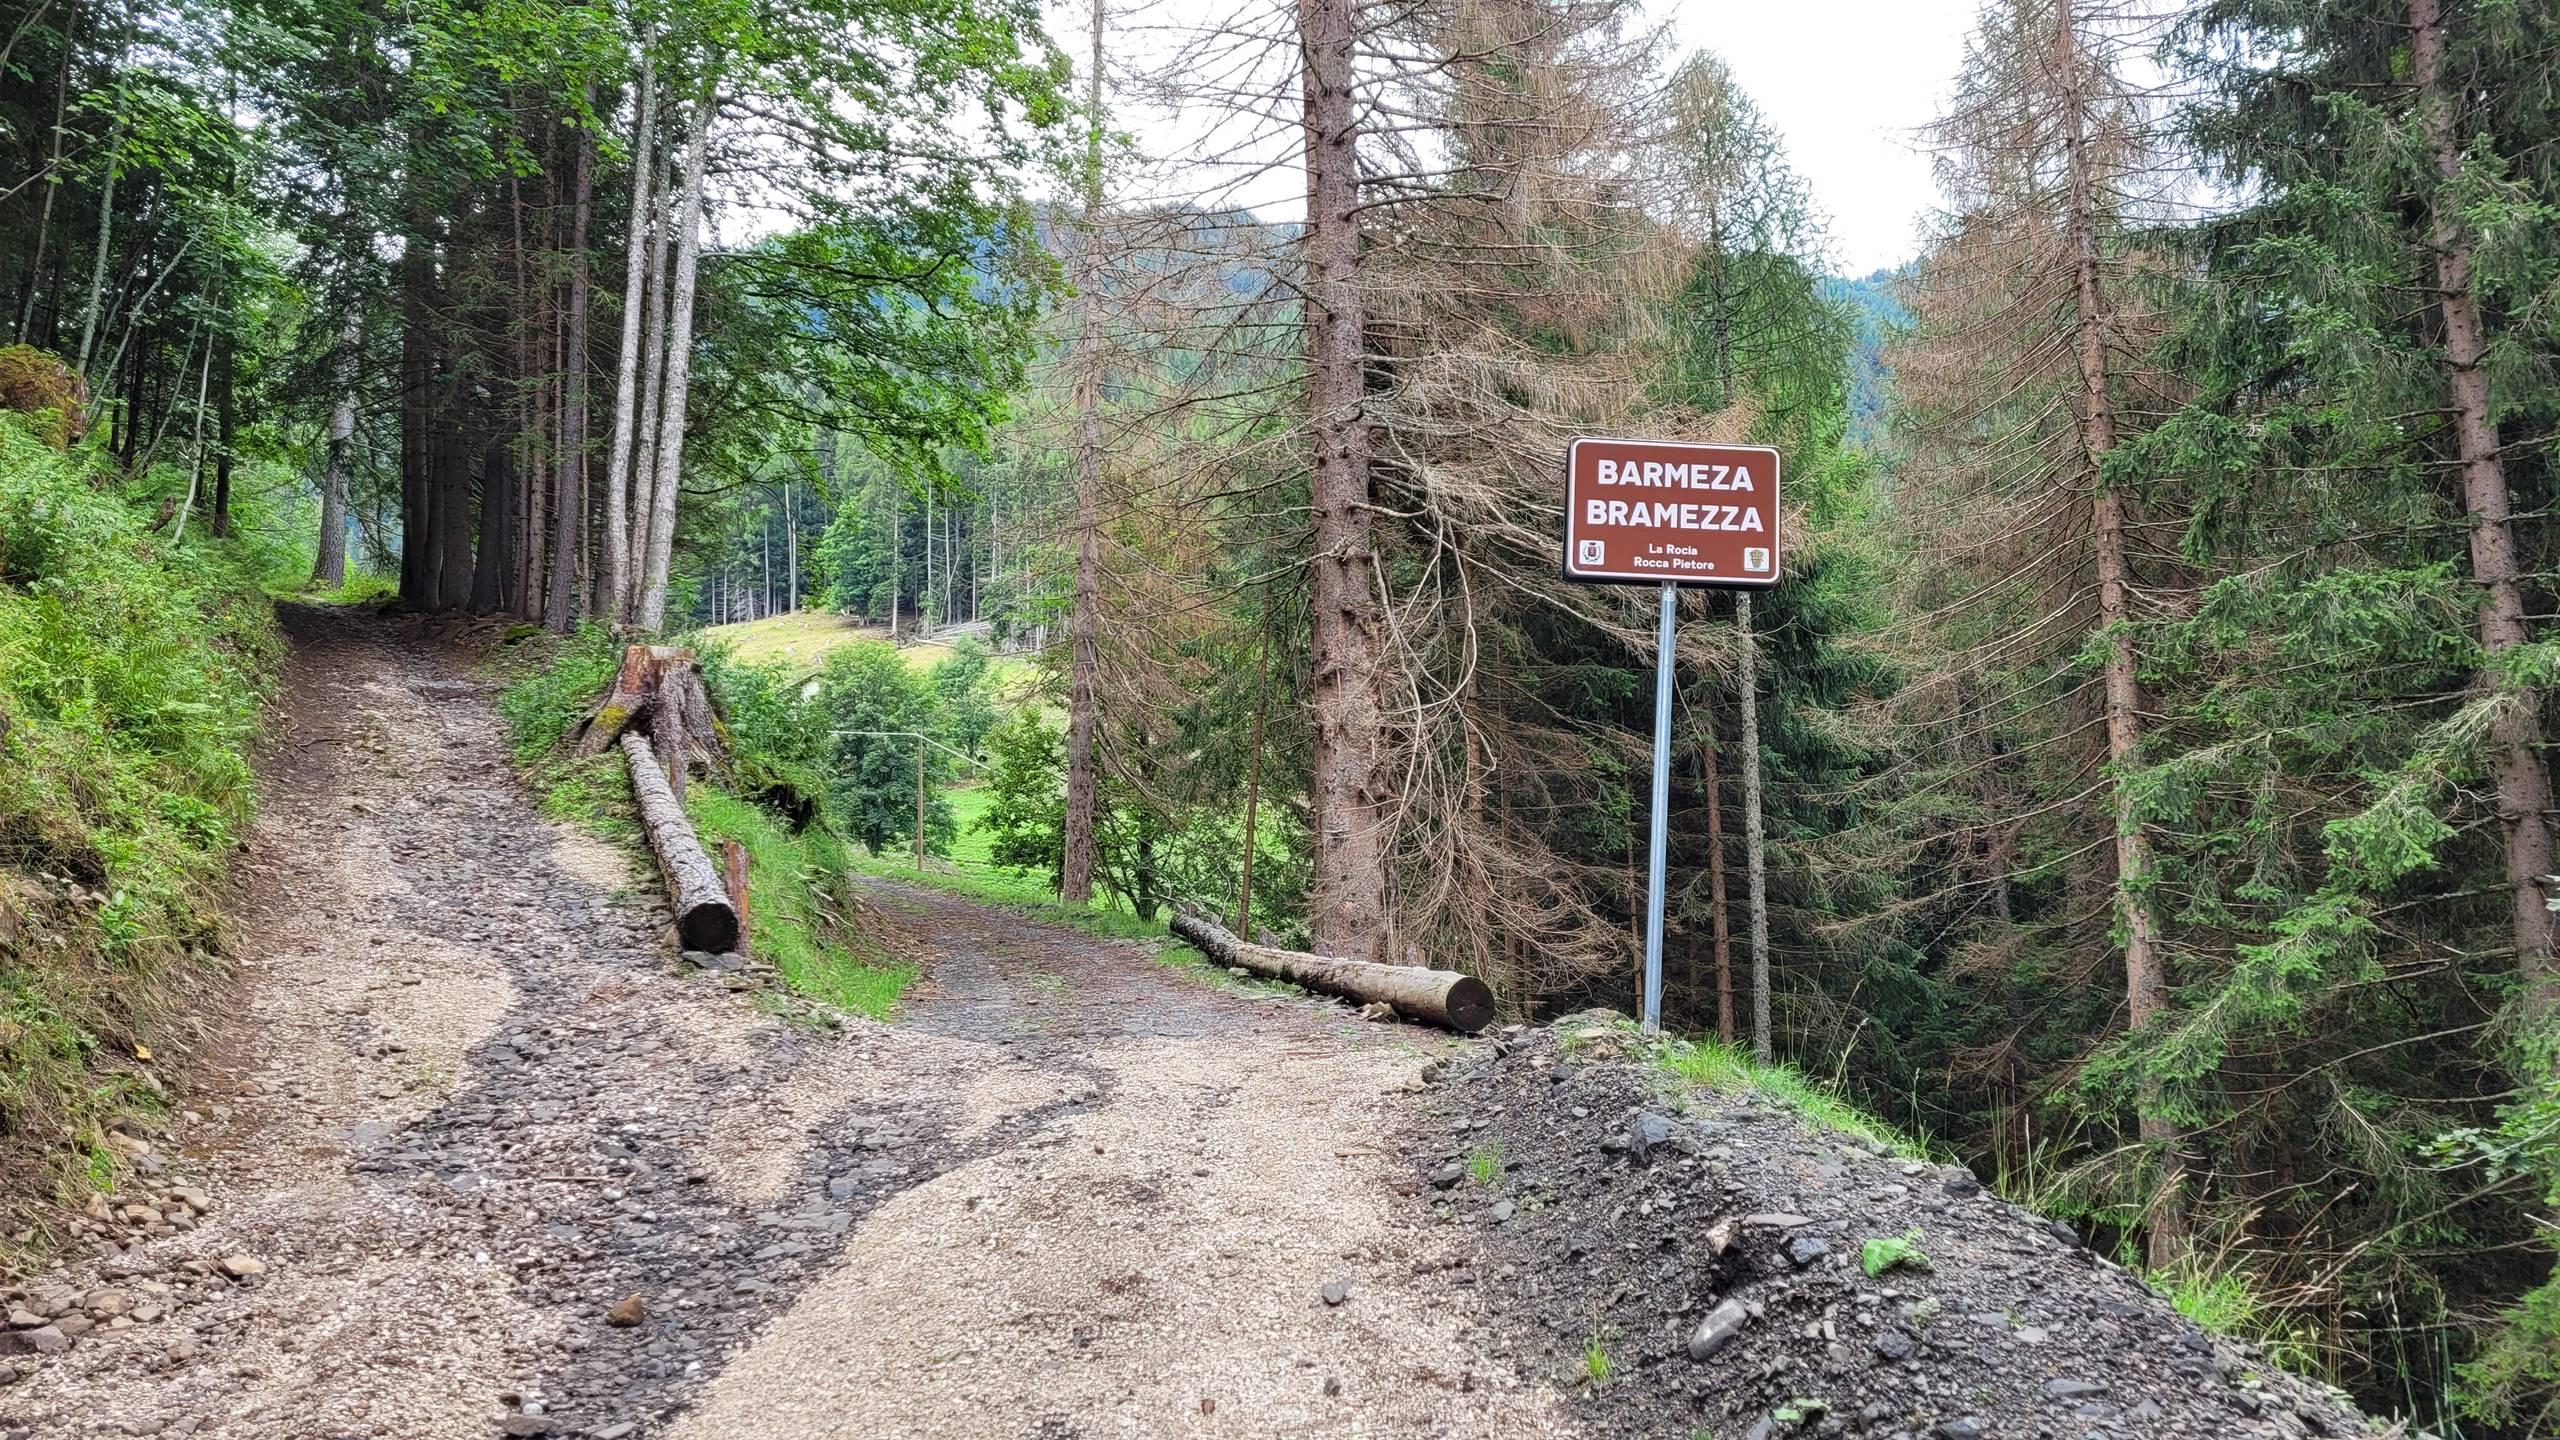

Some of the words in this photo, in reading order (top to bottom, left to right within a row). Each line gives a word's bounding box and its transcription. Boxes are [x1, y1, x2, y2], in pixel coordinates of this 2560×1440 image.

[1598, 459, 1754, 491] BARMEZA
[1587, 499, 1764, 532] BRAMEZZA
[1649, 543, 1663, 554] La
[1666, 544, 1698, 556] Rocia
[1633, 557, 1669, 568] Rocca
[1673, 558, 1715, 570] Pietore
